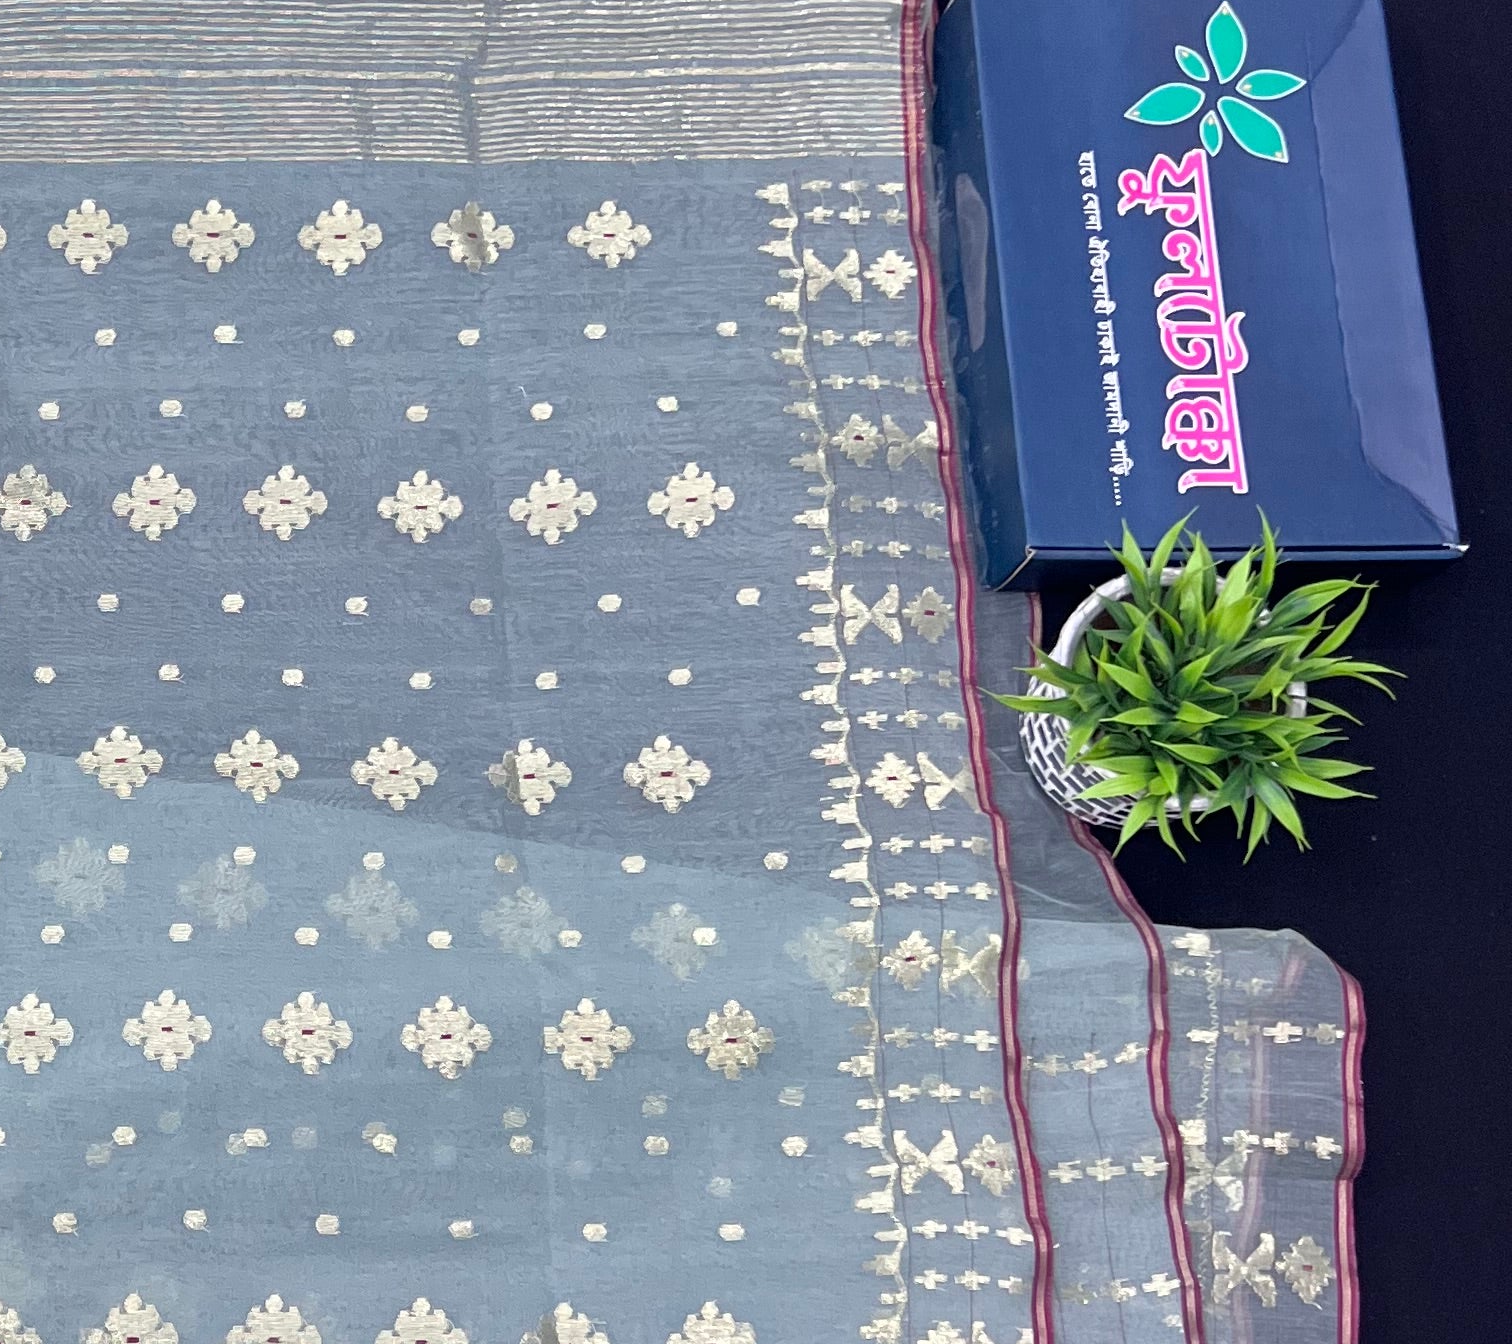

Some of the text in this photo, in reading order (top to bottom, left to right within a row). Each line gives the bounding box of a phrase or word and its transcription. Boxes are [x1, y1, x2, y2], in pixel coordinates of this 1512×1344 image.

[1078, 151, 1096, 189] হাতে
[1082, 191, 1102, 231] বোনা
[1097, 320, 1120, 366] ঢাকাই
